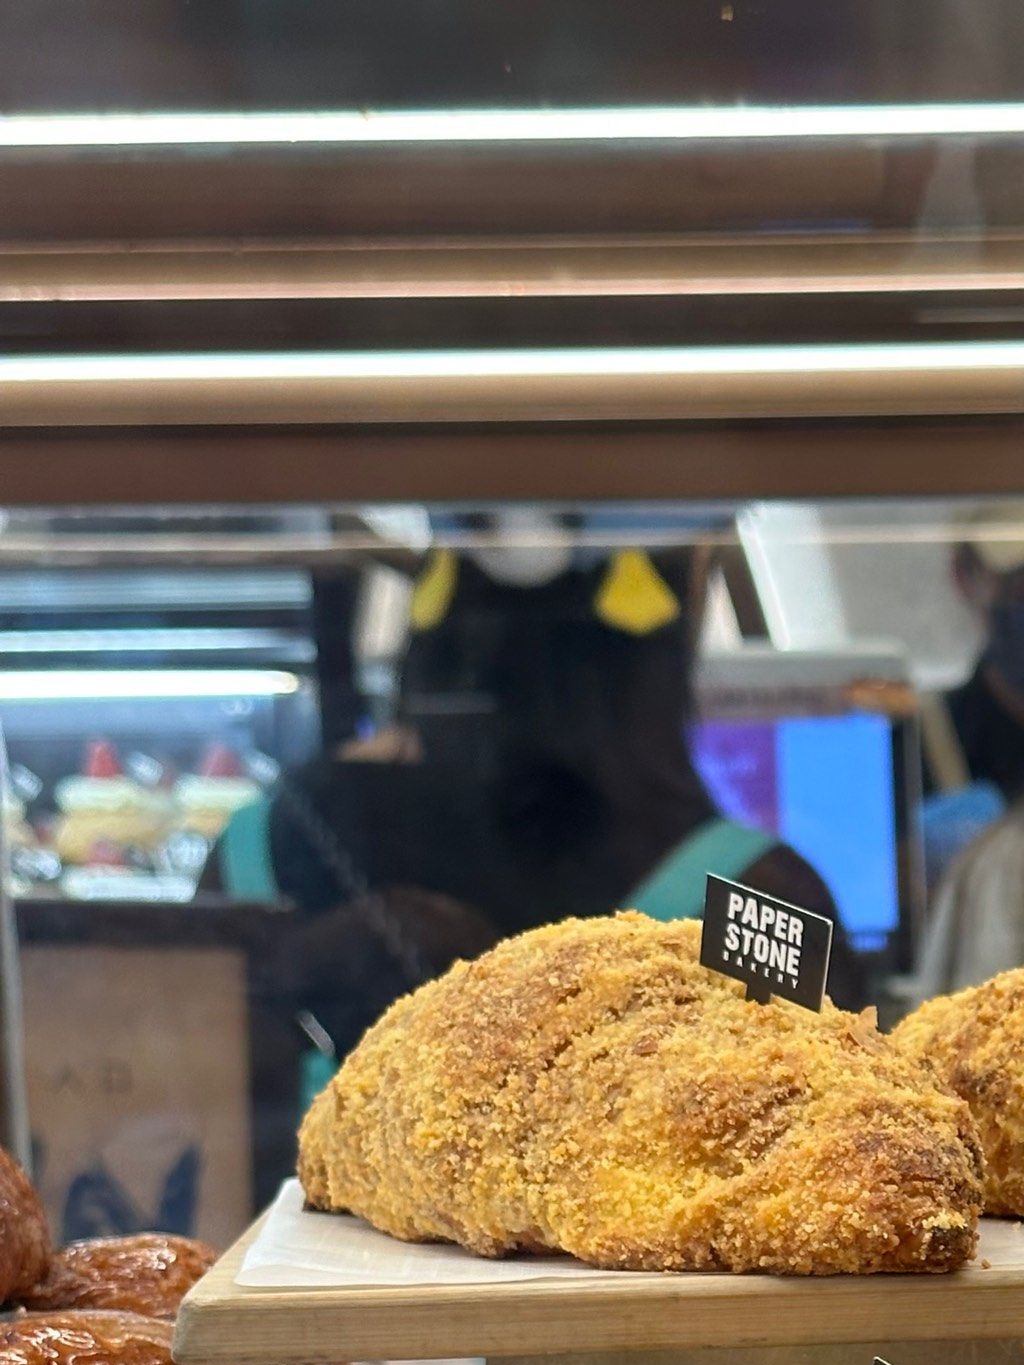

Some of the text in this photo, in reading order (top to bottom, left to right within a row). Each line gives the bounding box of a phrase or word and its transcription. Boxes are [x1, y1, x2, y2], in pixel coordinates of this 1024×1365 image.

[727, 892, 804, 947] PAPER
[722, 950, 799, 989] BAKERY
[724, 922, 801, 976] STONE
